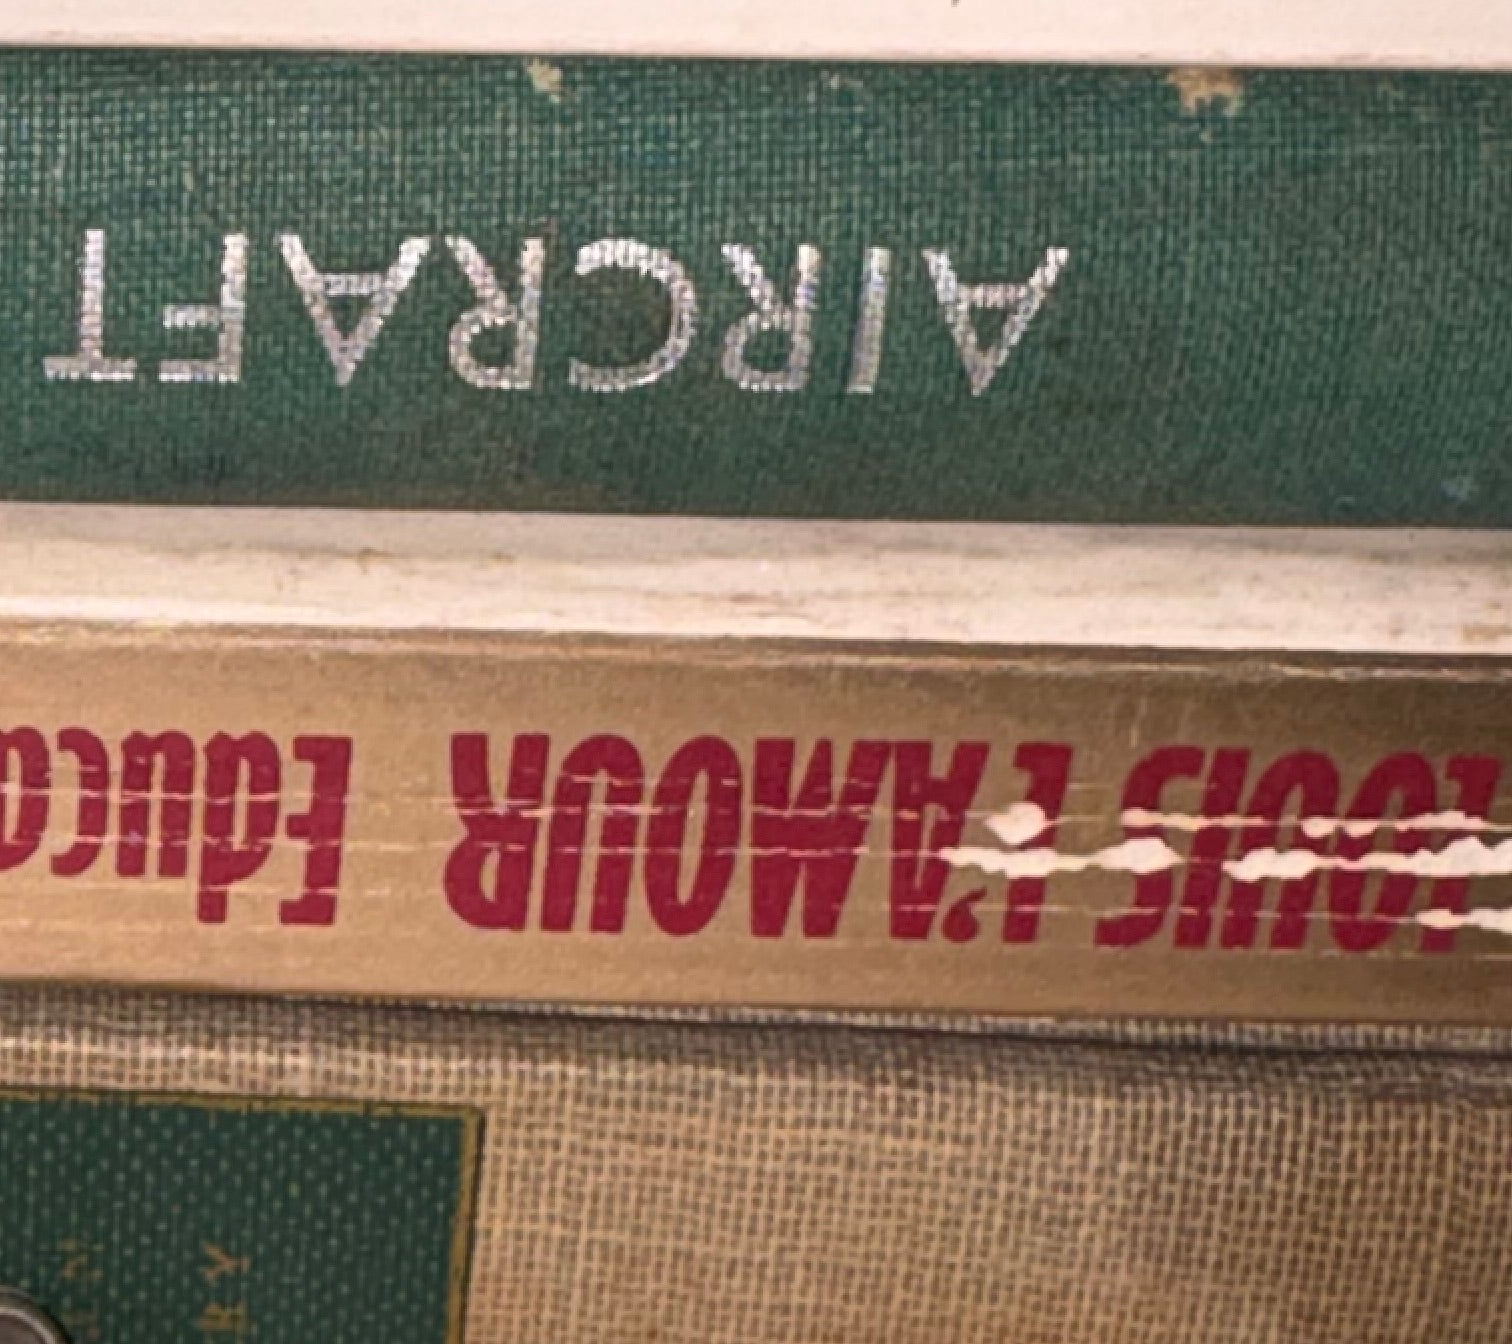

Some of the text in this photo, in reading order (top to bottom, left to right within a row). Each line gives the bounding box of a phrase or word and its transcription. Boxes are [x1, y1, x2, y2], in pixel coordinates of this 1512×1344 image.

[42, 226, 1071, 396] AIRCRAFT
[443, 732, 1076, 945] L'AMOUR
[1093, 743, 1504, 953] LOUIS
